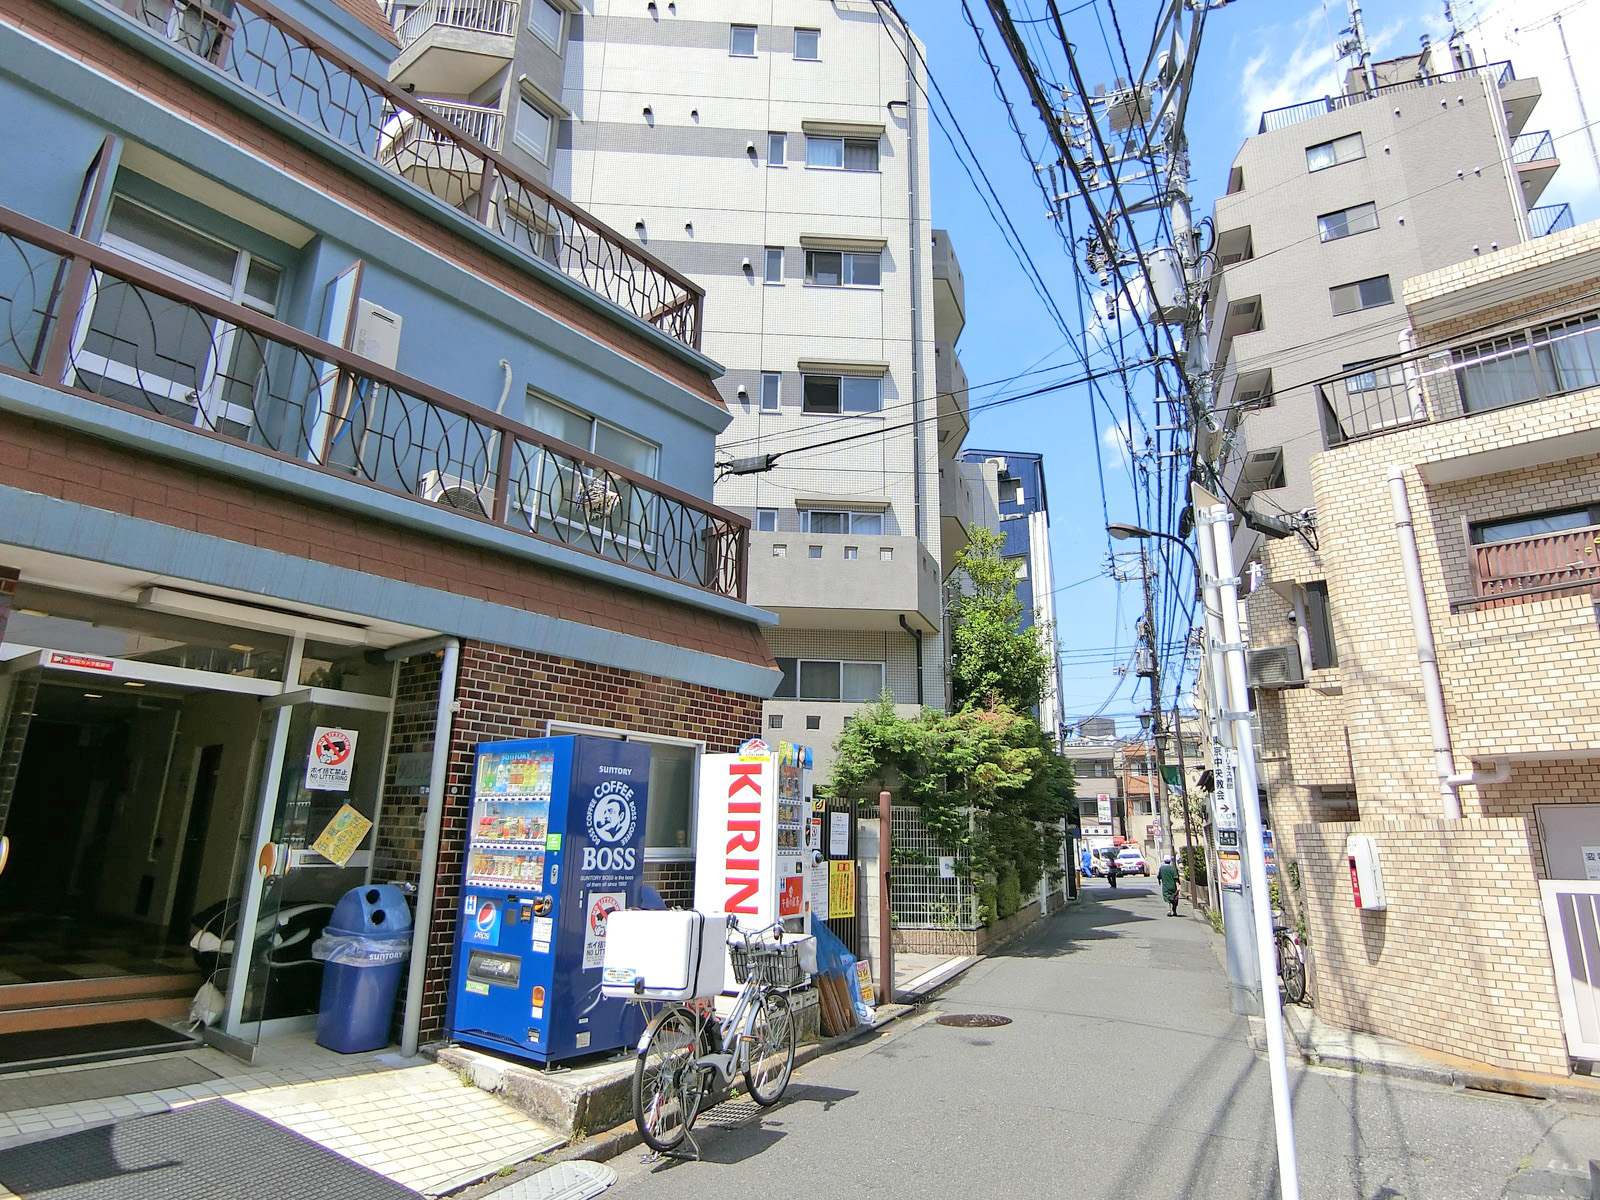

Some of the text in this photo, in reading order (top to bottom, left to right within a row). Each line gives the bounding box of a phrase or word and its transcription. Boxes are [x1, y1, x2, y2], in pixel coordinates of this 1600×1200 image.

[599, 765, 633, 776] SUNTORY
[594, 781, 635, 801] COFFEE
[724, 763, 762, 914] KIRIN
[581, 847, 636, 871] BOSS
[369, 952, 403, 960] SUNTORY
